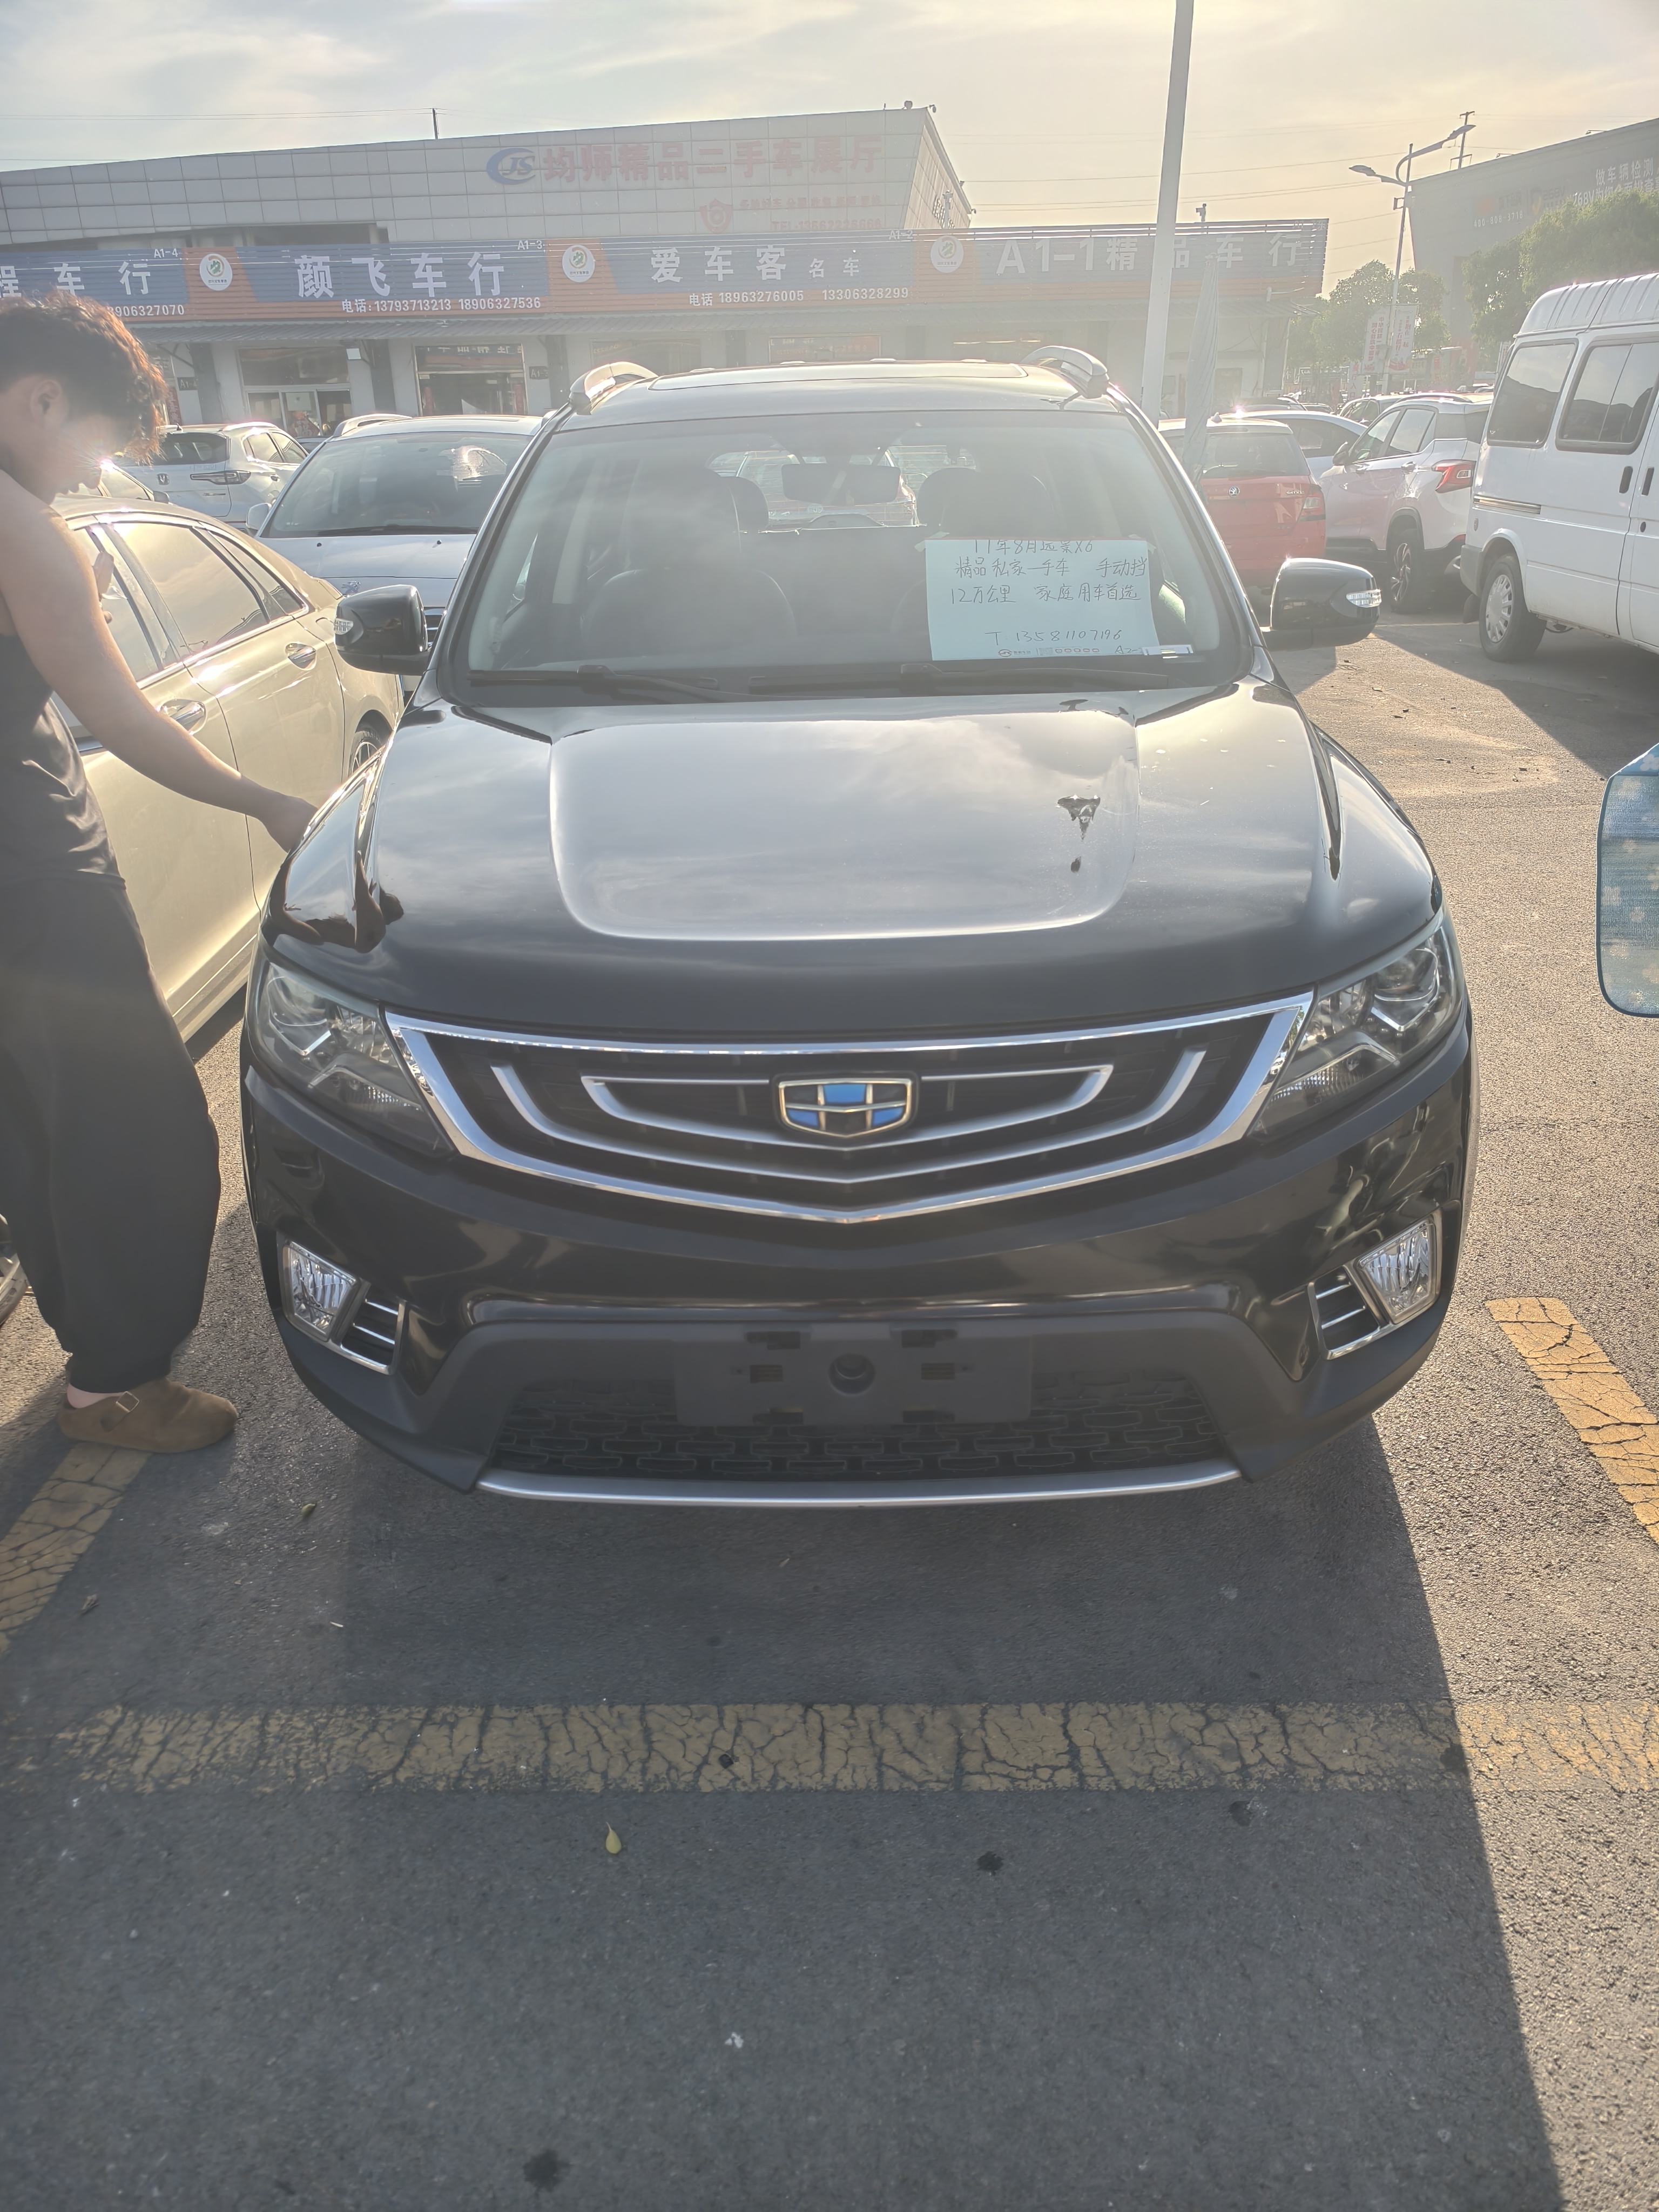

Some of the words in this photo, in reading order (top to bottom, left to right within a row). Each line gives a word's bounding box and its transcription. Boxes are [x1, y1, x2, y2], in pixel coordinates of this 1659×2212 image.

[1596, 157, 1659, 186] 做车辆检测
[1474, 211, 1523, 227] 400-808-3718
[888, 229, 914, 240] A1-2
[154, 248, 179, 258] A1-4
[517, 240, 543, 250] A1-3
[651, 245, 787, 283] 爱车客
[810, 257, 860, 279] 名车
[294, 251, 504, 299] 颜飞车行
[458, 296, 541, 310] 18906327536
[689, 293, 713, 307] 电话
[719, 290, 804, 304] 18963276005
[822, 287, 909, 301] 13306328299
[1096, 557, 1149, 577] 手动挡
[952, 584, 1016, 604] 12万公里
[1035, 583, 1142, 602] 家庭用车首选
[1016, 629, 1122, 642] 13581107196
[1115, 645, 1142, 654] A2-
